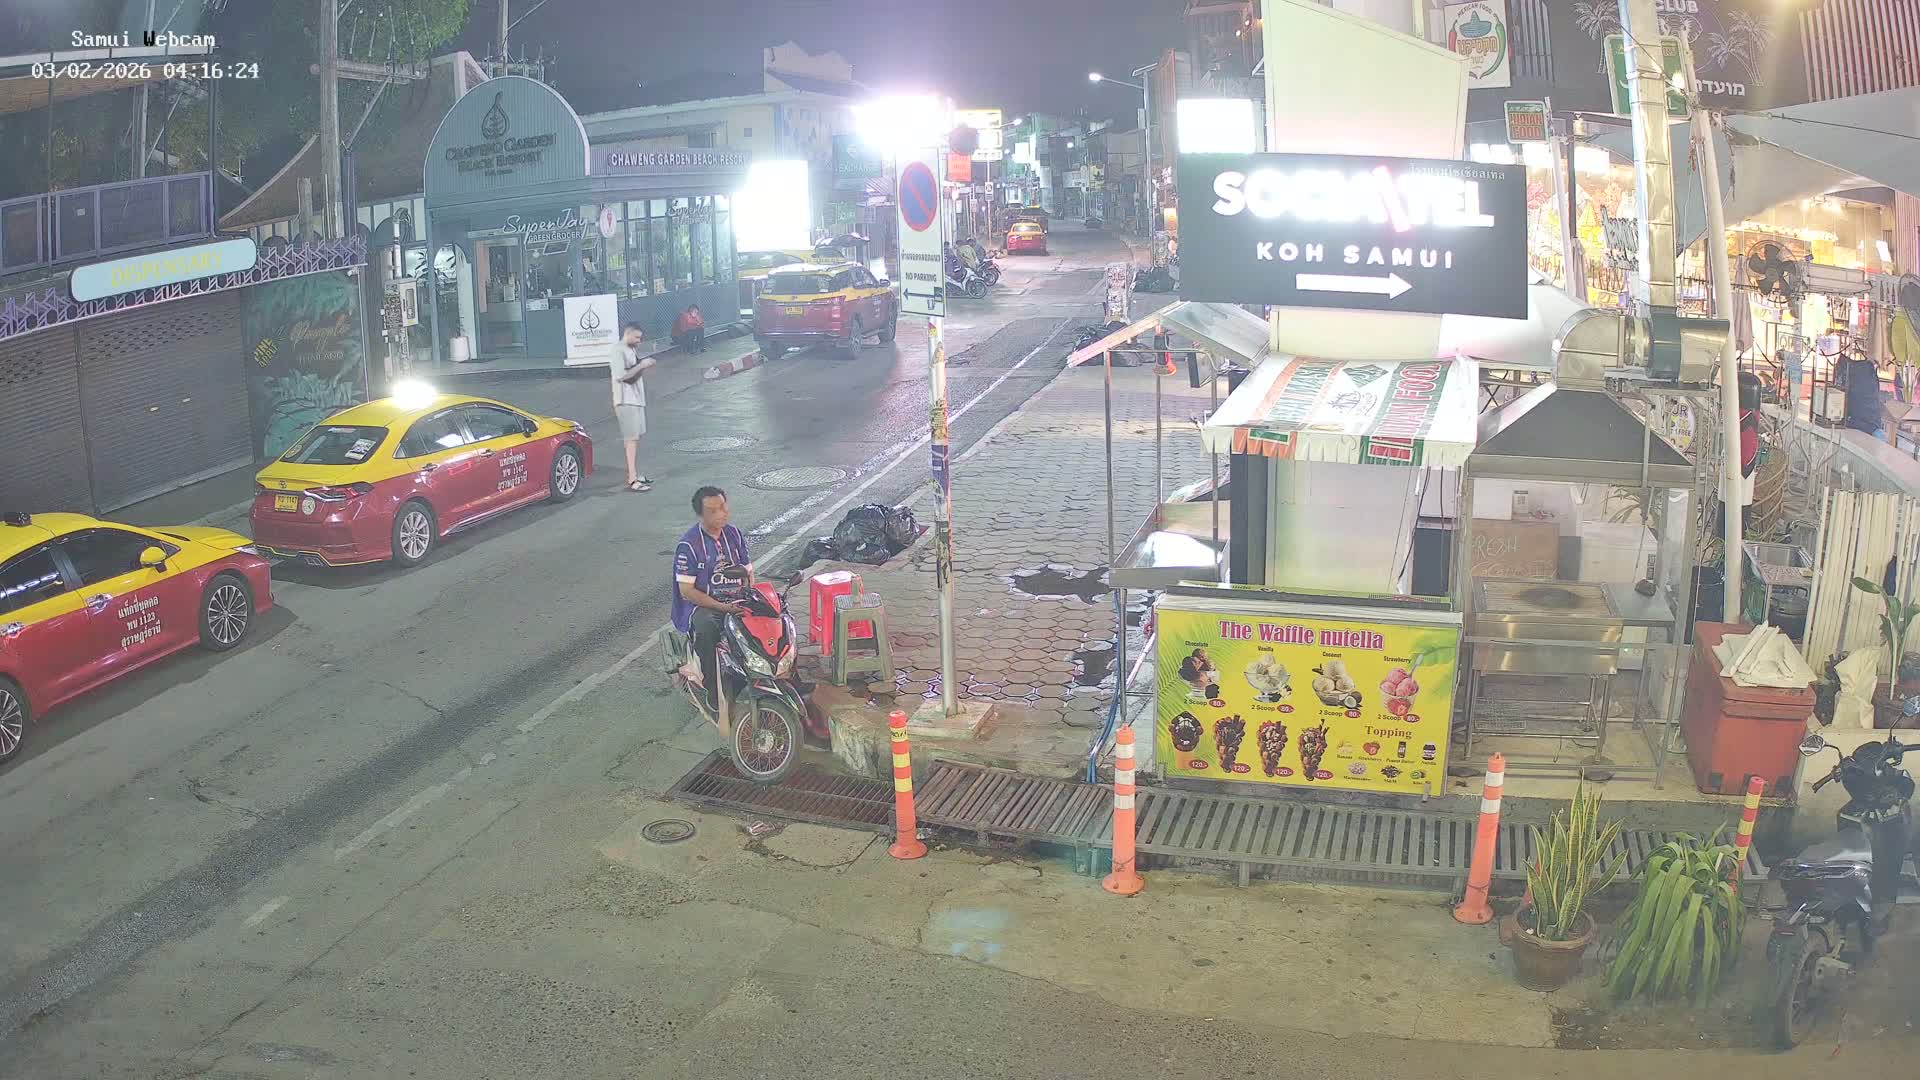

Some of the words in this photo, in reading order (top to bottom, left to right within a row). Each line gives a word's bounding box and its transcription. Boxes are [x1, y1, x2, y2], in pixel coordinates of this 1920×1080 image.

[611, 153, 654, 166] CHAWENG
[658, 153, 690, 166] GARDEN
[693, 154, 717, 166] BEACH
[1256, 242, 1324, 262] KOH
[1343, 245, 1452, 269] SAMUI
[111, 250, 223, 288] DISPENSARY
[905, 272, 914, 280] NO
[914, 273, 937, 282] PARKING
[139, 612, 156, 626] 1123
[1219, 620, 1252, 640] The
[1258, 623, 1315, 645] Waffle
[1319, 629, 1384, 650] nutella
[1365, 725, 1412, 739] Topping
